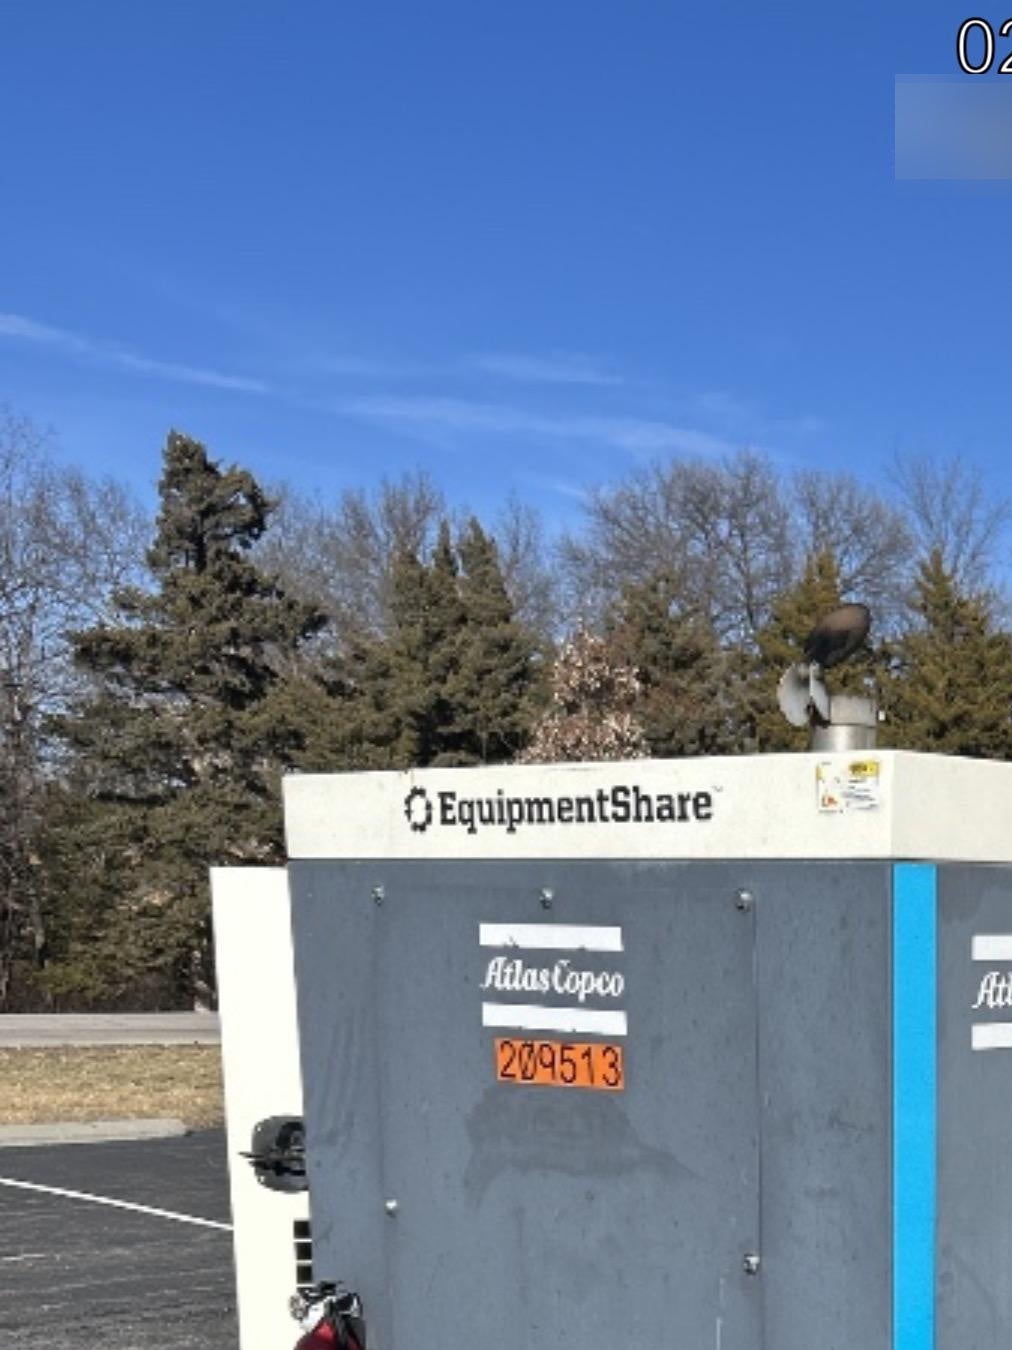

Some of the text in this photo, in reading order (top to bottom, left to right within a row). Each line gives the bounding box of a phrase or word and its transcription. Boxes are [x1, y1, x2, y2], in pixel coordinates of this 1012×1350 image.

[438, 786, 713, 834] EquipmentShare
[480, 956, 625, 1002] Atlas Copco
[499, 1039, 621, 1087] 209513
